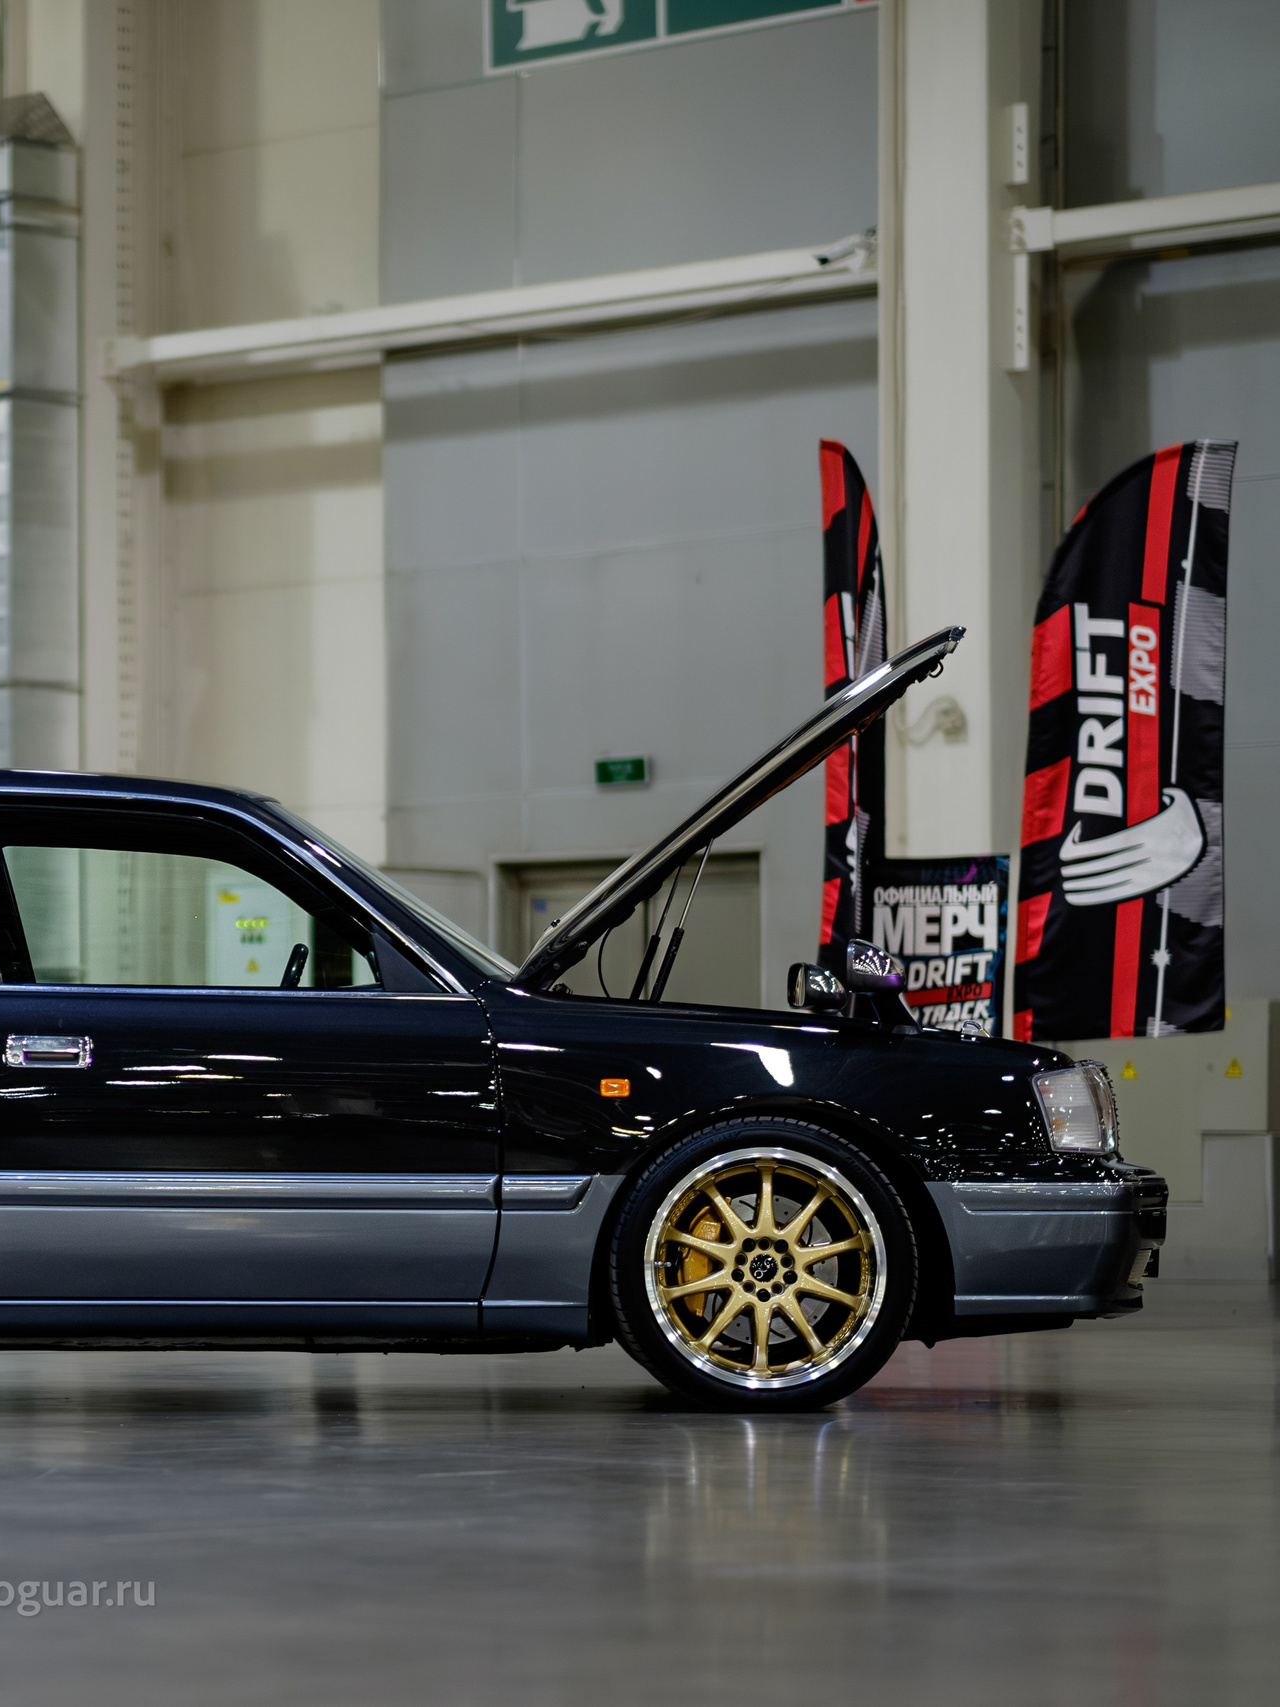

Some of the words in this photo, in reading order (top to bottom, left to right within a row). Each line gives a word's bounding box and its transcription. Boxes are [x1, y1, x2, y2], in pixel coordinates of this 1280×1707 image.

[1128, 624, 1157, 716] EXPO
[1073, 602, 1125, 818] DRIFT
[873, 880, 998, 907] ОФИЦИАЛЬНЫЙ
[872, 902, 998, 956] МЕРЧ
[907, 951, 993, 991] DRIFT
[921, 999, 991, 1026] TRACK
[946, 984, 983, 1001] EXPO
